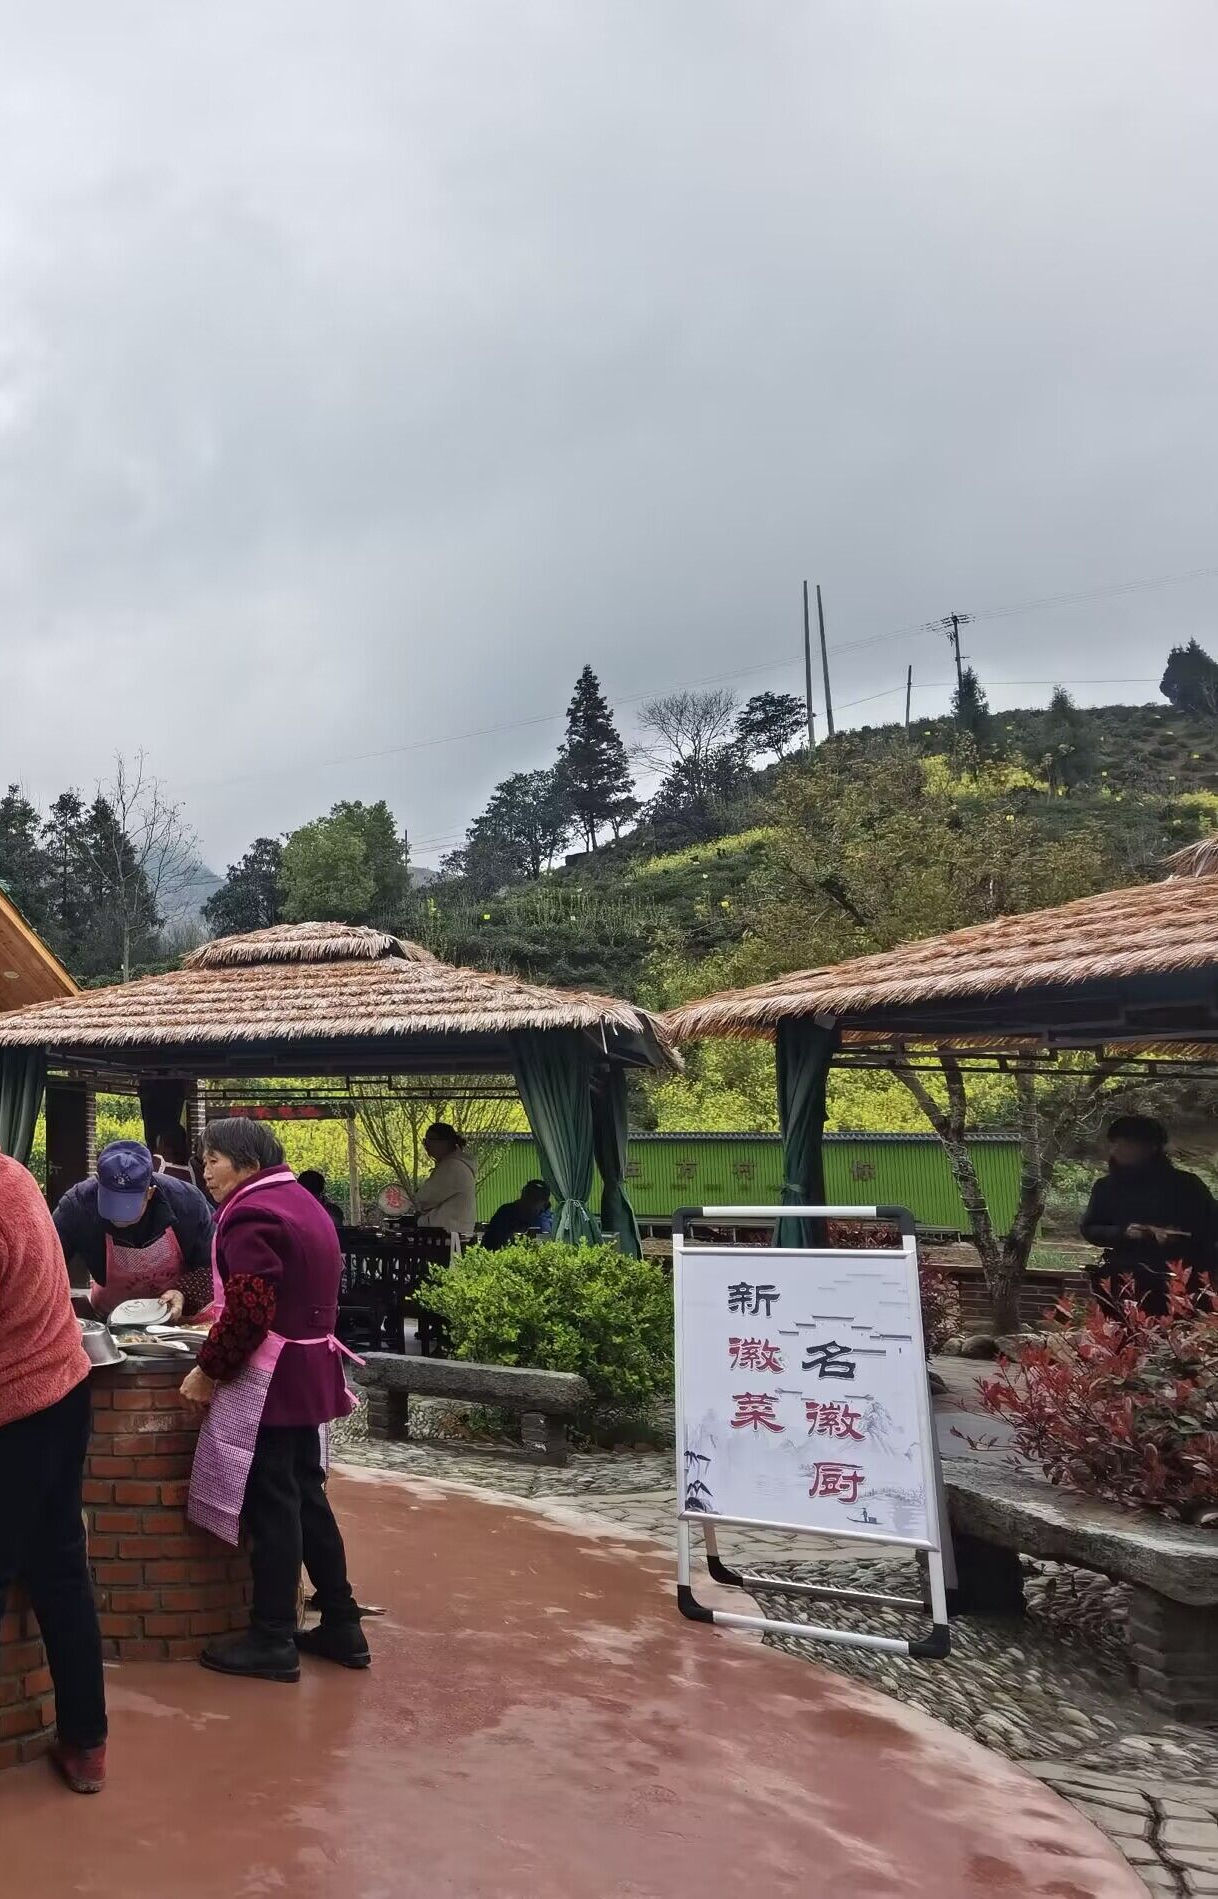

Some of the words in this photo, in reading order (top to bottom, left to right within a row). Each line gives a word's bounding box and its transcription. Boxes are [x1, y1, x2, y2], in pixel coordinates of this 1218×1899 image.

[727, 1281, 786, 1432] 新徽菜
[801, 1340, 866, 1504] 名徽厨
